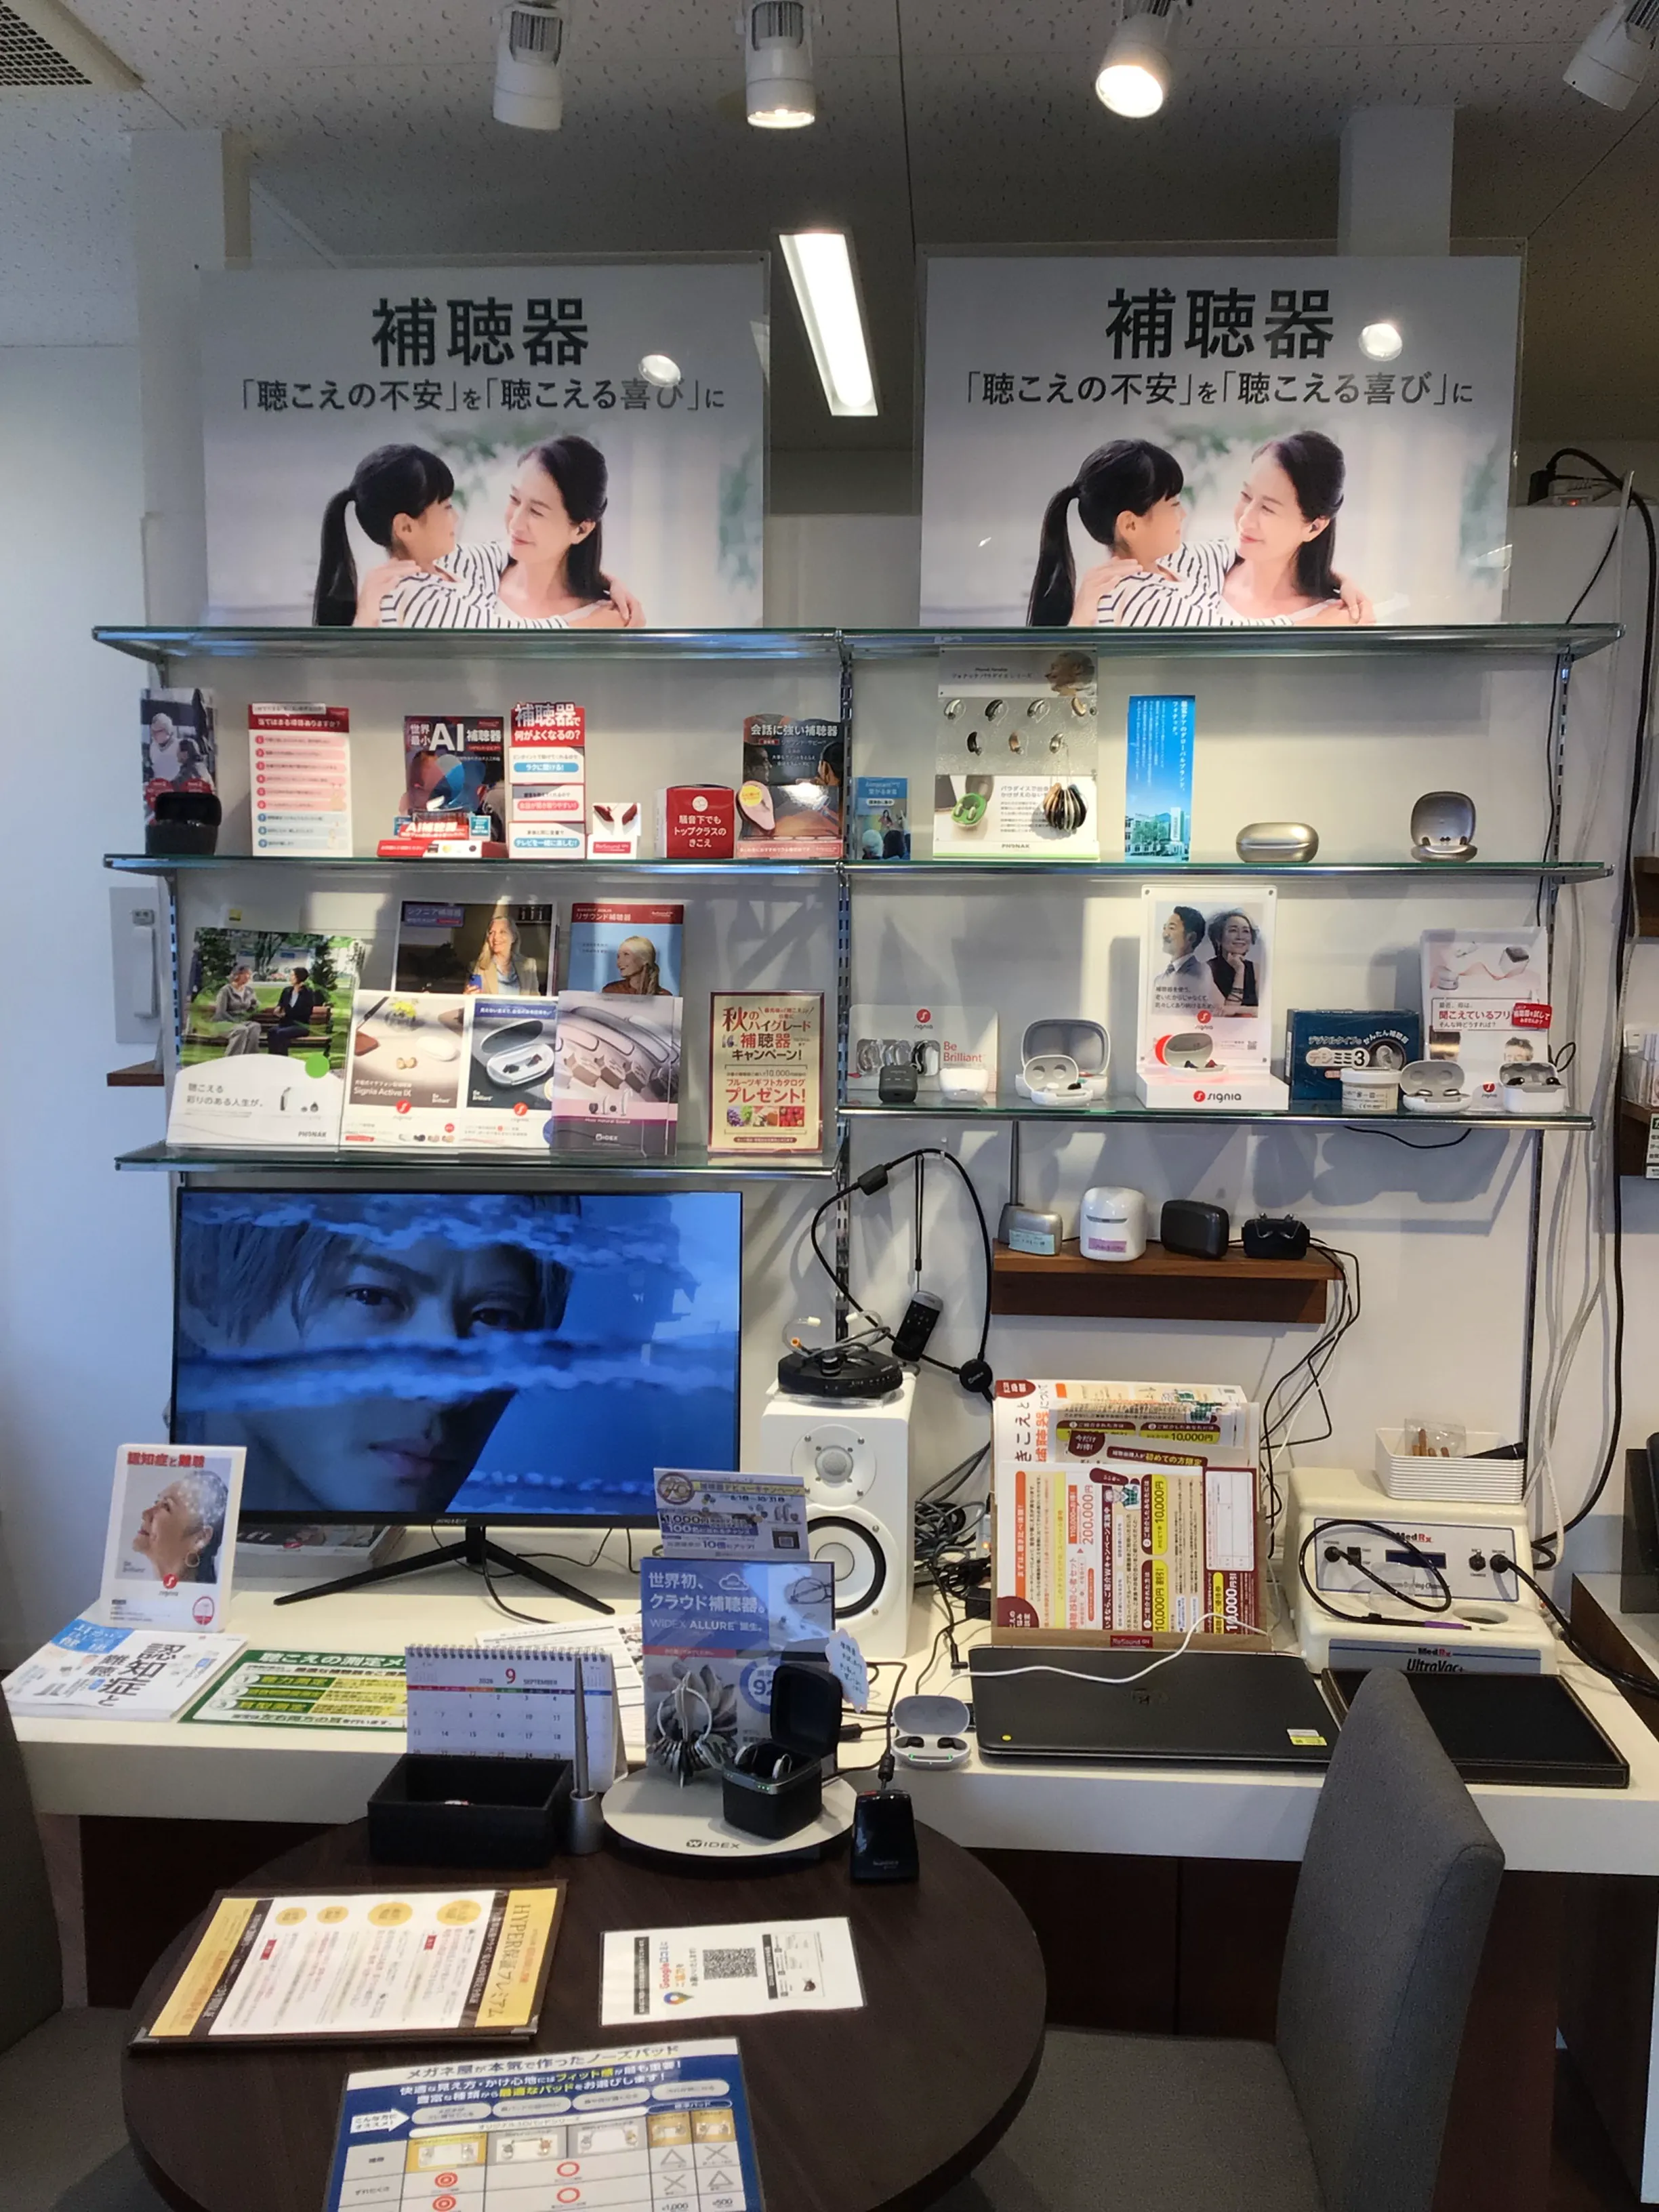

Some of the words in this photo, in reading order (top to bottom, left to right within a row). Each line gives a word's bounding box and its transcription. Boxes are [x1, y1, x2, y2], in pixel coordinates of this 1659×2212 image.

[1106, 287, 1334, 360] 補聴器
[372, 298, 588, 367] 補聴器
[243, 379, 725, 411] 「聴こえの不安」を「聴こえる喜び」に
[968, 371, 1473, 406] 「聴こえの不安」を「聴こえる喜び」に
[515, 703, 581, 727] 補聴器で
[466, 729, 501, 742] 補聴器
[514, 730, 581, 741] 何がよくなるの?
[751, 724, 838, 737] 会話に強い補聴器
[428, 723, 465, 752] AI
[678, 815, 722, 825] 騒音下でも
[674, 826, 727, 836] トップクラスの
[689, 838, 712, 848] きこえ
[747, 1020, 812, 1032] ハイグレード
[740, 1033, 792, 1048] 補聴器
[943, 1041, 958, 1051] Be
[732, 1049, 802, 1061] キャンペーン!
[943, 1052, 983, 1063] Brilliant
[1309, 1050, 1366, 1067] デジミミ3
[187, 1082, 224, 1093] 聴こえる
[726, 1078, 806, 1087] フルーツギフトカタログ
[354, 1086, 377, 1097] Signia
[378, 1088, 403, 1097] Active
[725, 1088, 806, 1103] プレゼント!
[1207, 1092, 1242, 1103] signia
[186, 1095, 264, 1107] 彩りのある人生が。
[1170, 1432, 1214, 1441] 10,000円
[1155, 1481, 1164, 1524] 10,000円
[1082, 1484, 1094, 1545] 200,000円
[648, 1572, 703, 1590] 世界初、
[649, 1593, 765, 1614] クラウド補聴器。
[1155, 1588, 1164, 1631] 10,000円
[649, 1618, 687, 1628] WIDEX
[689, 1620, 734, 1631] ALLURE
[1418, 1647, 1452, 1657] MedRx
[506, 1667, 516, 1685] 9
[685, 1839, 740, 1849] WIDEX
[407, 2046, 679, 2079] メガネ屋が本気で作ったノーズパッド
